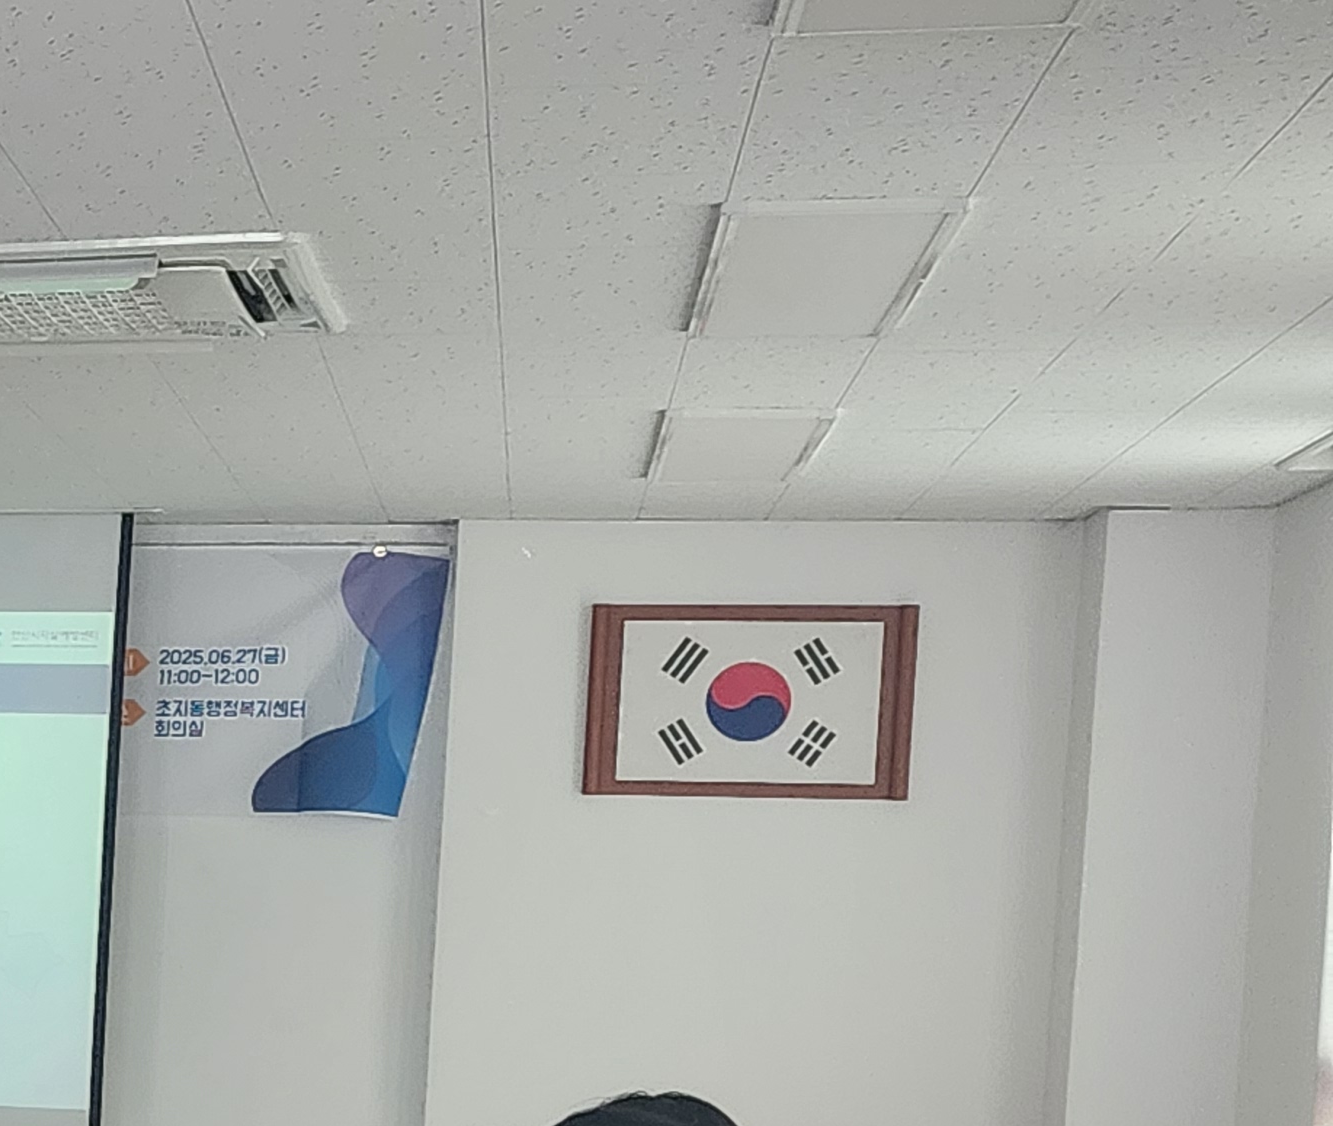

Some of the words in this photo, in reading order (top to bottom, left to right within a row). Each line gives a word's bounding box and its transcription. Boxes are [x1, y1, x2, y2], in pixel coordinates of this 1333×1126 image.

[158, 647, 287, 667] 2025.06.27(금)
[154, 699, 307, 720] 초지동행정복지센터
[153, 720, 205, 738] 회의실
